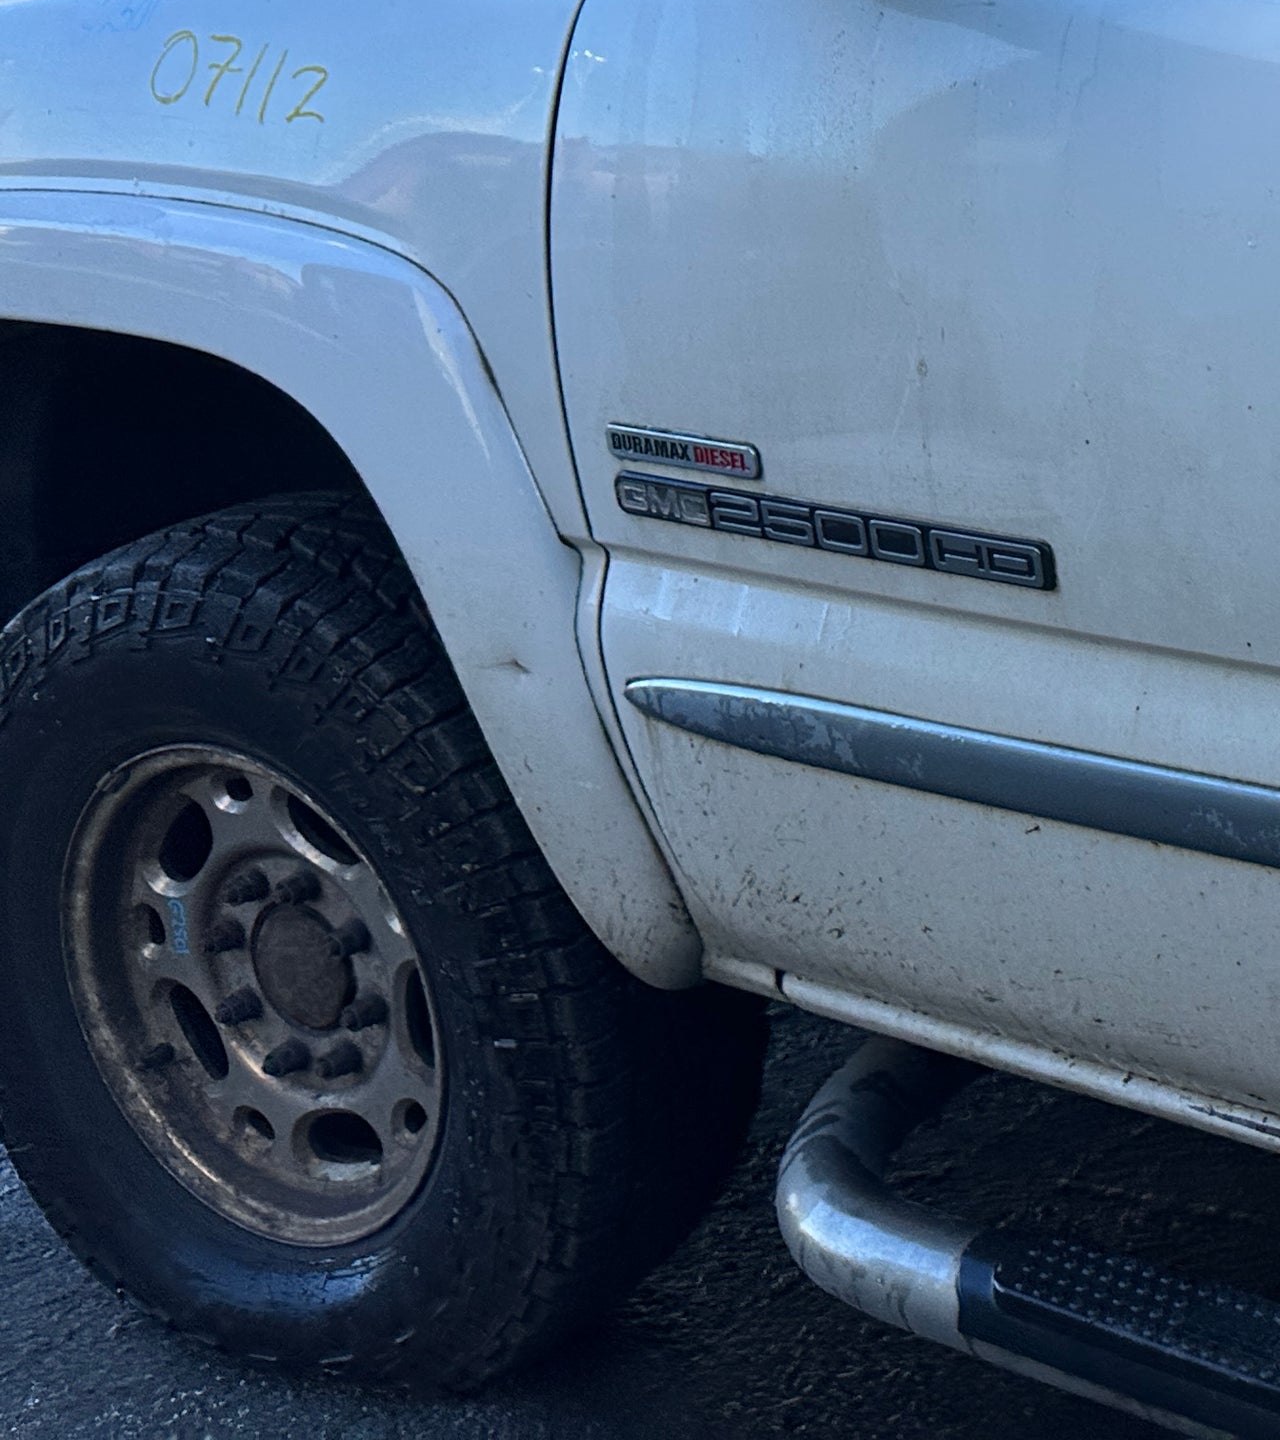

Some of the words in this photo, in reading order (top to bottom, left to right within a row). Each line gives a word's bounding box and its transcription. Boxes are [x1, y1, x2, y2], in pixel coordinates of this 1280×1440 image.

[610, 431, 692, 462] DURAMAX
[693, 445, 750, 472] DIESEL
[619, 482, 710, 527] GMC
